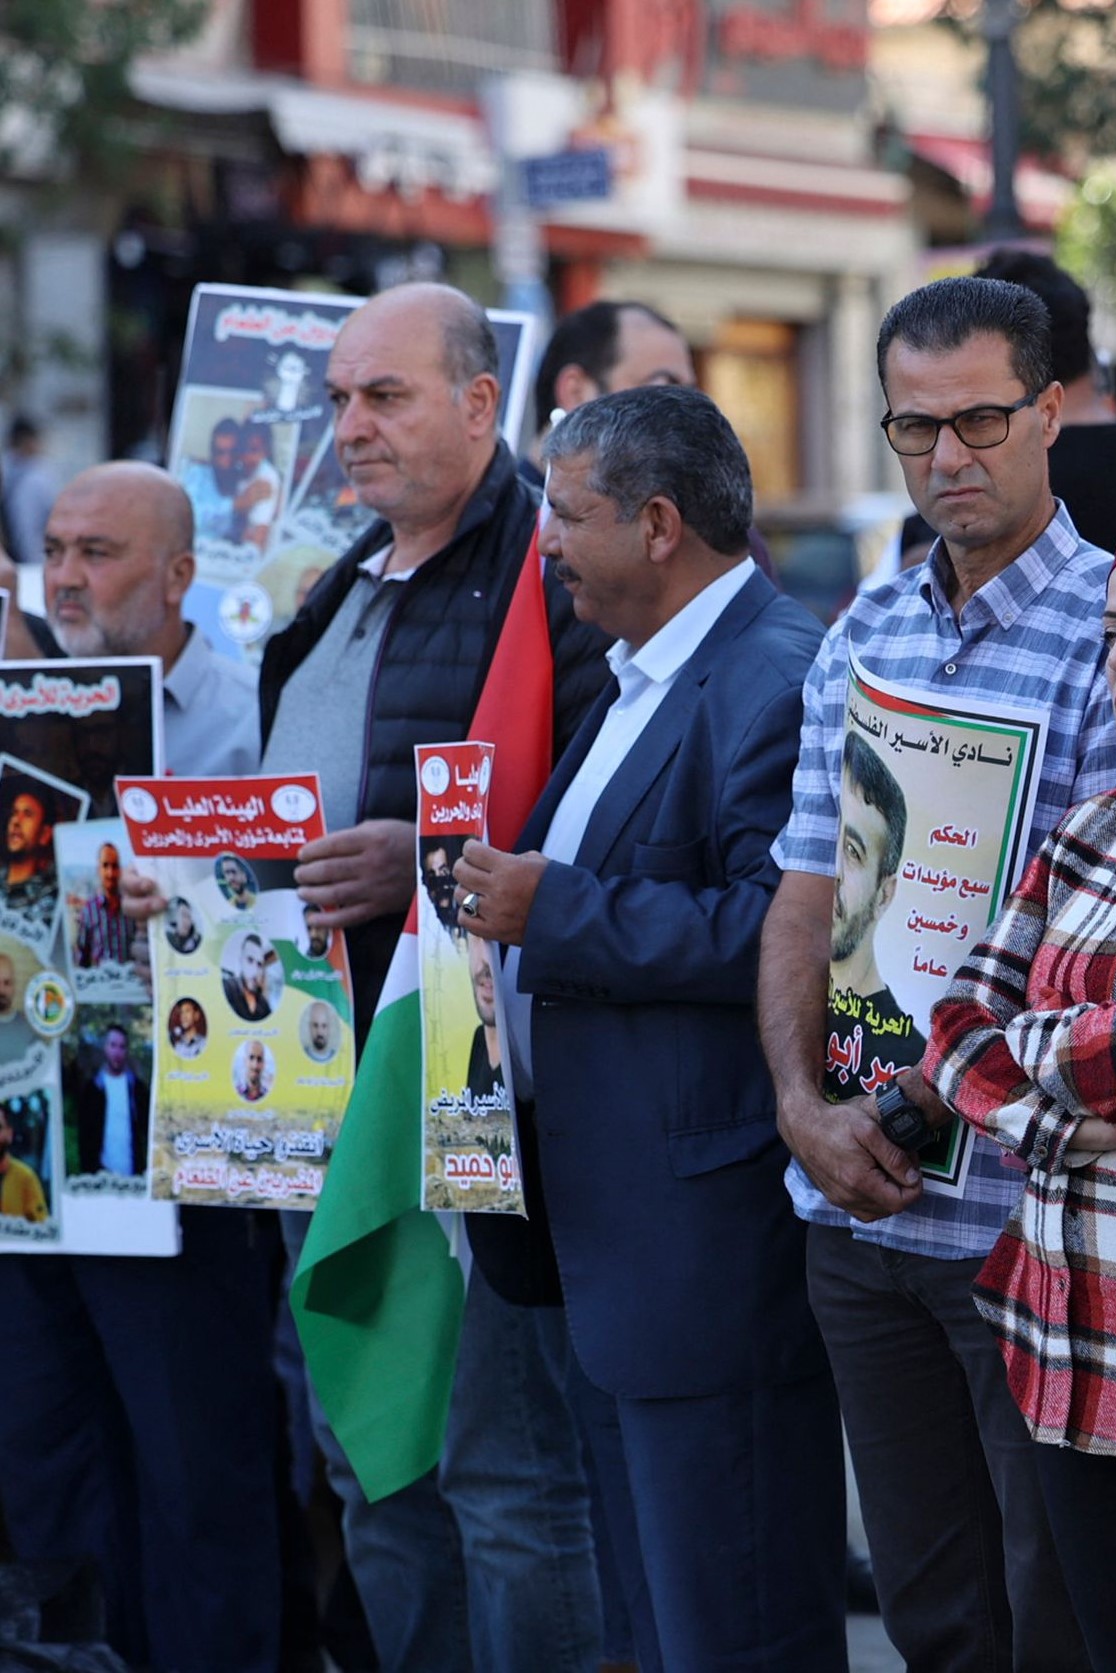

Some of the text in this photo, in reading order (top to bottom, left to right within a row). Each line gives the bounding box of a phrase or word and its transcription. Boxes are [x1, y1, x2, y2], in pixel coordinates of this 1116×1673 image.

[889, 729, 949, 755] الأسير
[952, 742, 1013, 767] نادي
[162, 795, 265, 822] الهيئة العليا
[142, 823, 307, 849] لمتابعة شؤون الأسرى والمحررين
[929, 825, 977, 848] الحكم
[902, 861, 991, 898] سبع مؤبدات
[906, 909, 969, 941] وخمسين
[865, 1000, 911, 1037] الحرية
[174, 1122, 233, 1157] الأسرى
[233, 1129, 273, 1160] حياة
[172, 1160, 227, 1196] الطعام
[227, 1166, 255, 1196] عن
[445, 1152, 495, 1190] حميد
